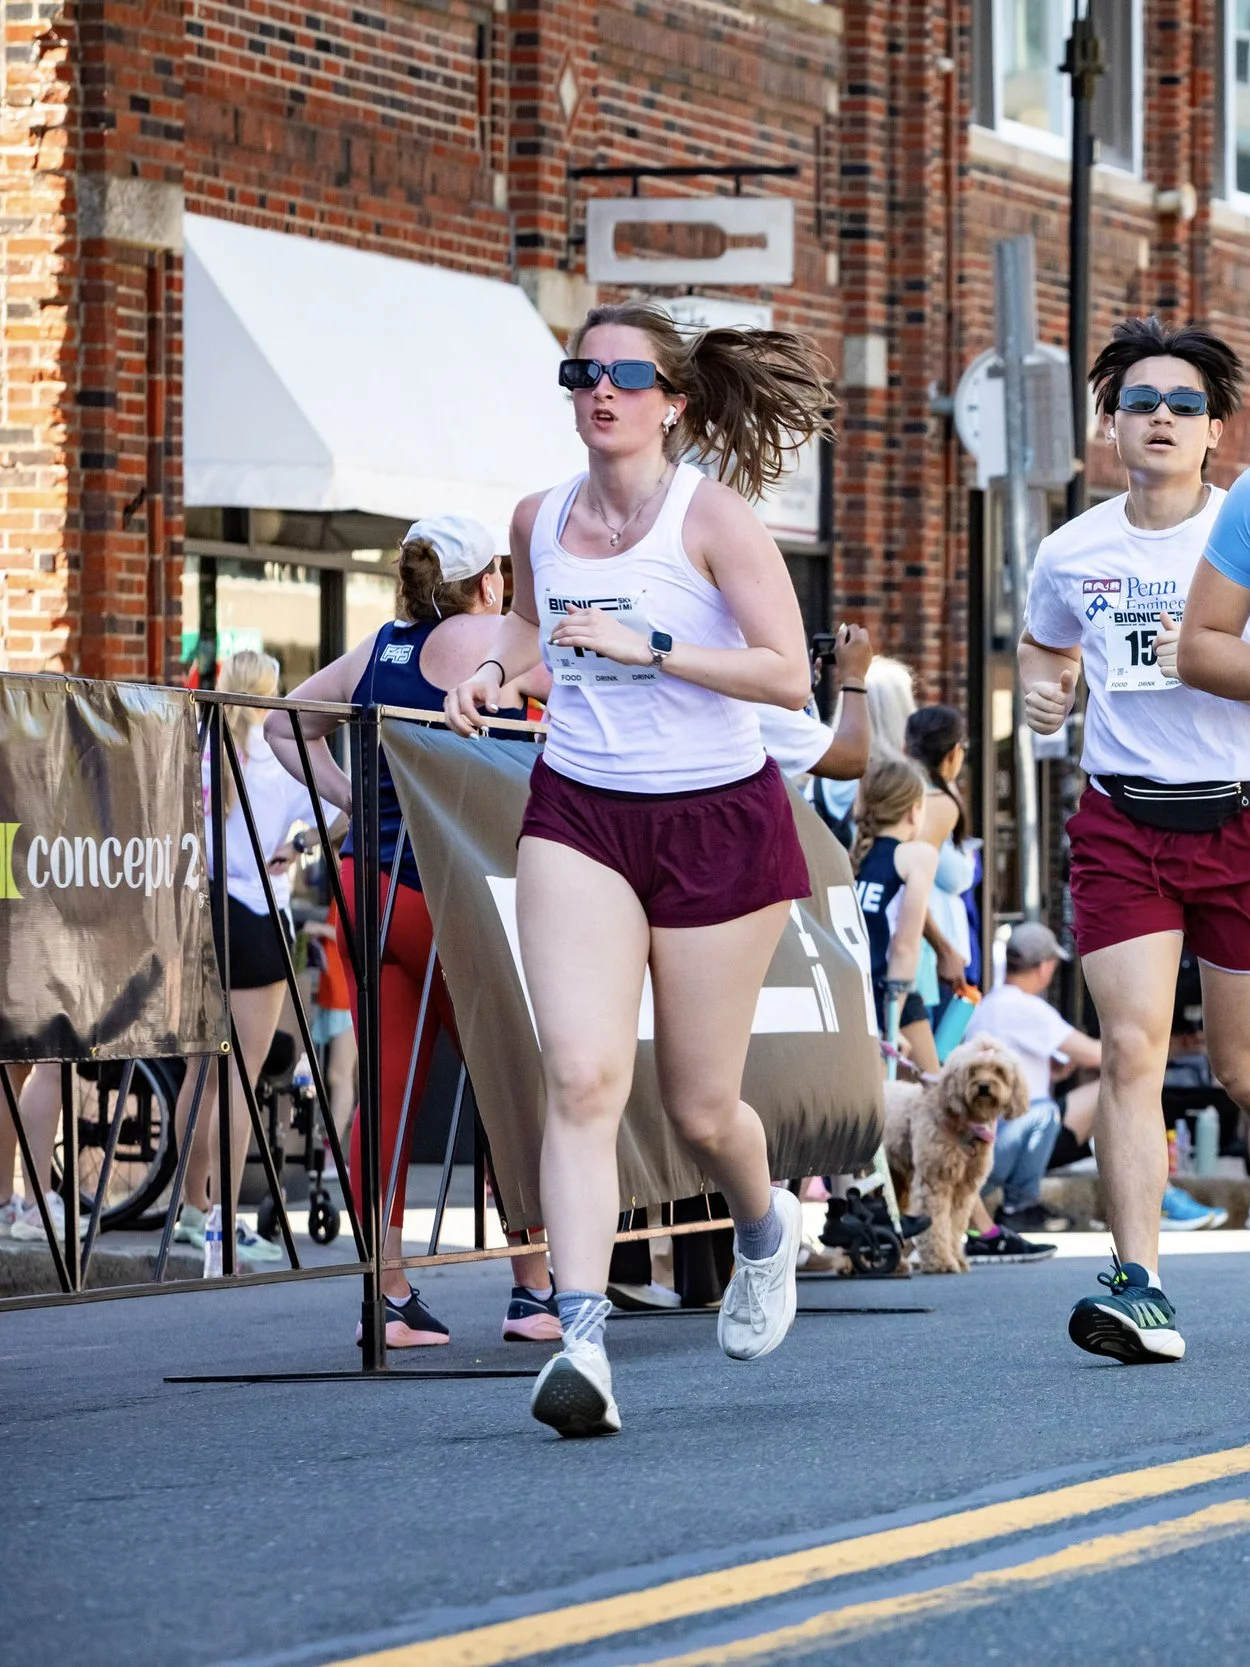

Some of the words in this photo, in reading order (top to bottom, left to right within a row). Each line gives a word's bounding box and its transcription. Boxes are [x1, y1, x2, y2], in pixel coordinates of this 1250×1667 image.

[1127, 577, 1176, 598] Penn
[632, 673, 656, 681] DRINK
[27, 834, 174, 896] concept
[181, 832, 200, 891] 2
